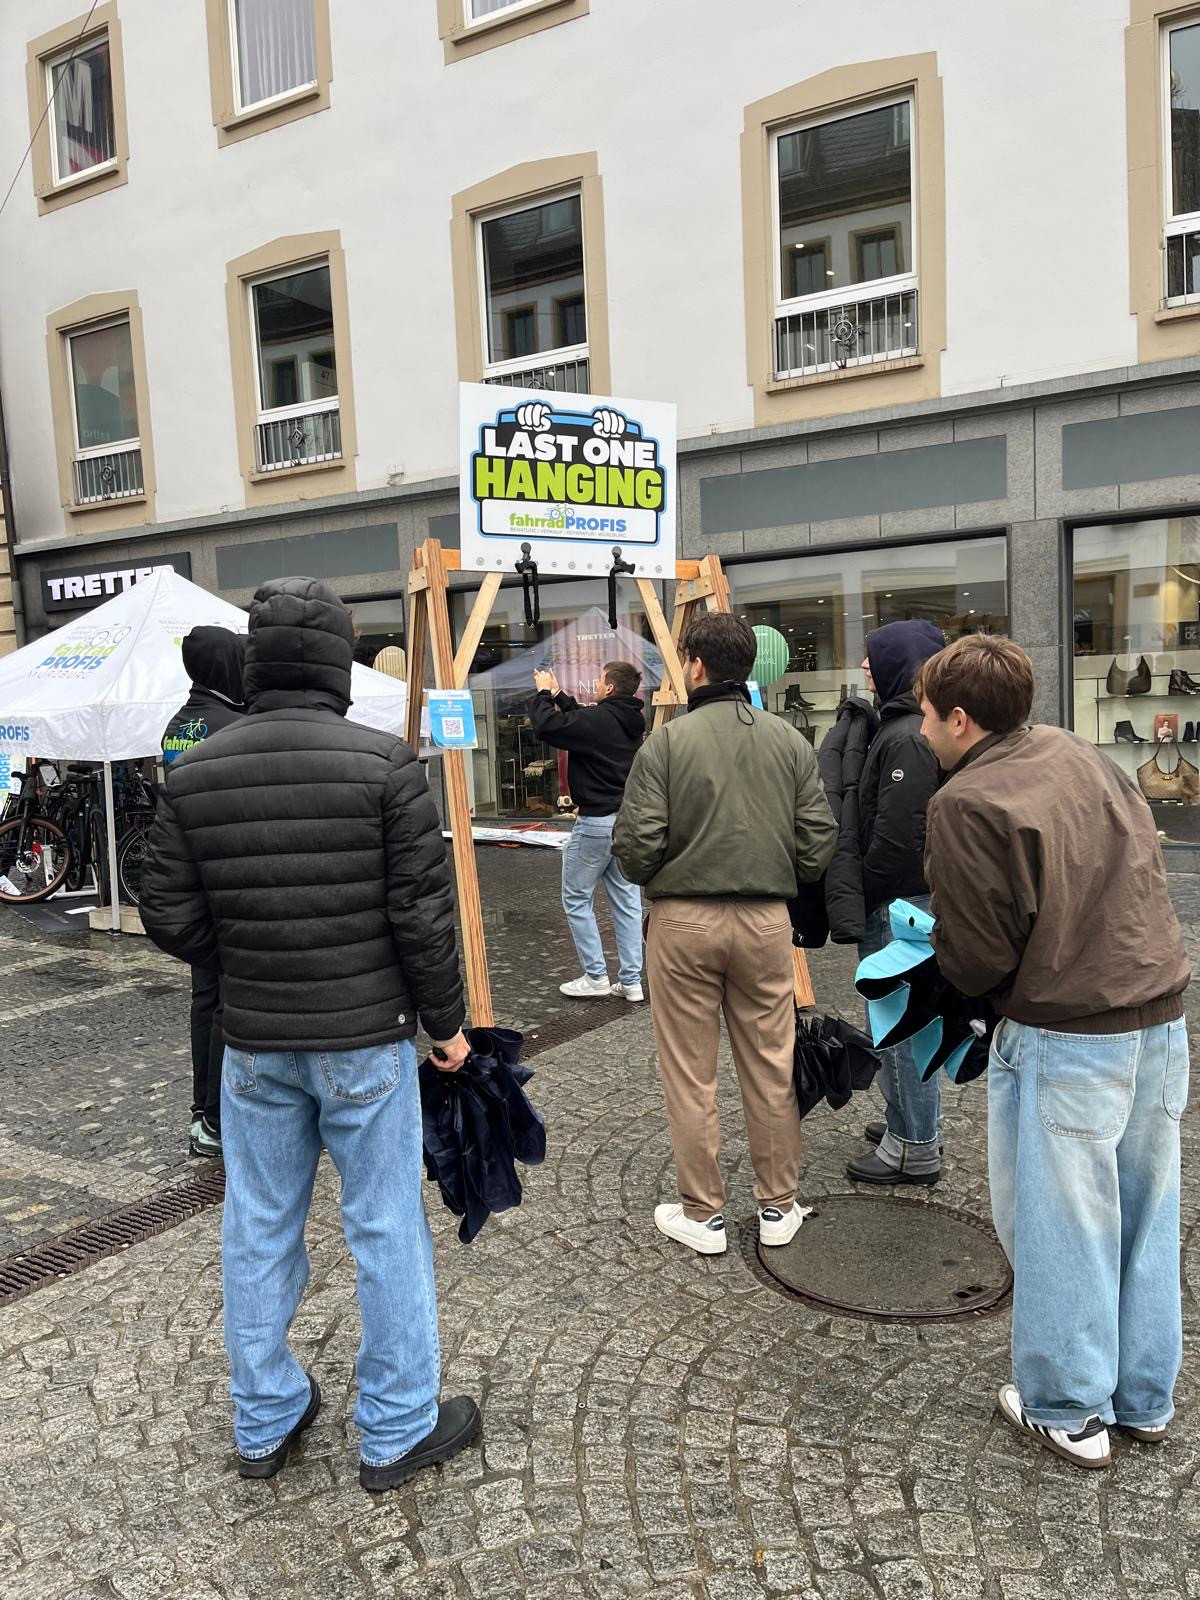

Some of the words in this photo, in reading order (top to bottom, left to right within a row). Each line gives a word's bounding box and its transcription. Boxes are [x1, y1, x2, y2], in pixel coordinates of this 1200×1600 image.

[484, 429, 579, 462] LAST
[582, 437, 655, 469] ONE
[476, 457, 662, 509] HANGING
[47, 565, 168, 600] TRETTE
[579, 679, 600, 694] NE
[0, 725, 30, 741] ROFIS
